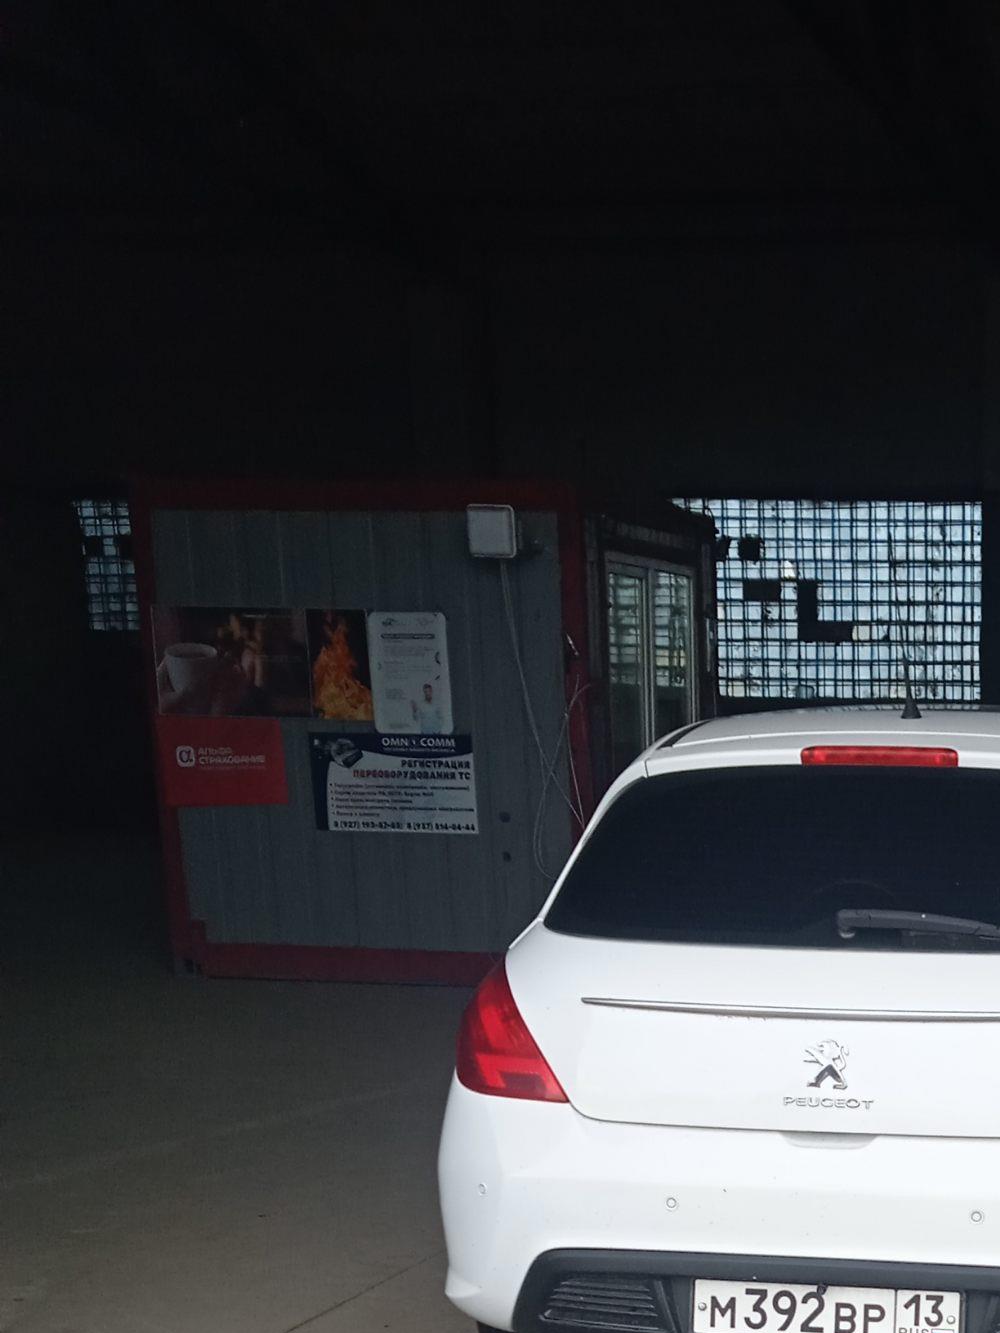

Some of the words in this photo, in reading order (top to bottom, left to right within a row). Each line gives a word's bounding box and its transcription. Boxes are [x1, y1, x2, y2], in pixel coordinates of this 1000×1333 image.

[400, 760, 471, 770] РЕГИСТРАЦИЯ
[353, 769, 456, 781] ПЕРЕОБОРУДОВАНИЯ
[458, 771, 471, 780] ТС
[783, 1096, 874, 1110] PEUGEOT
[902, 1294, 944, 1327] 13
